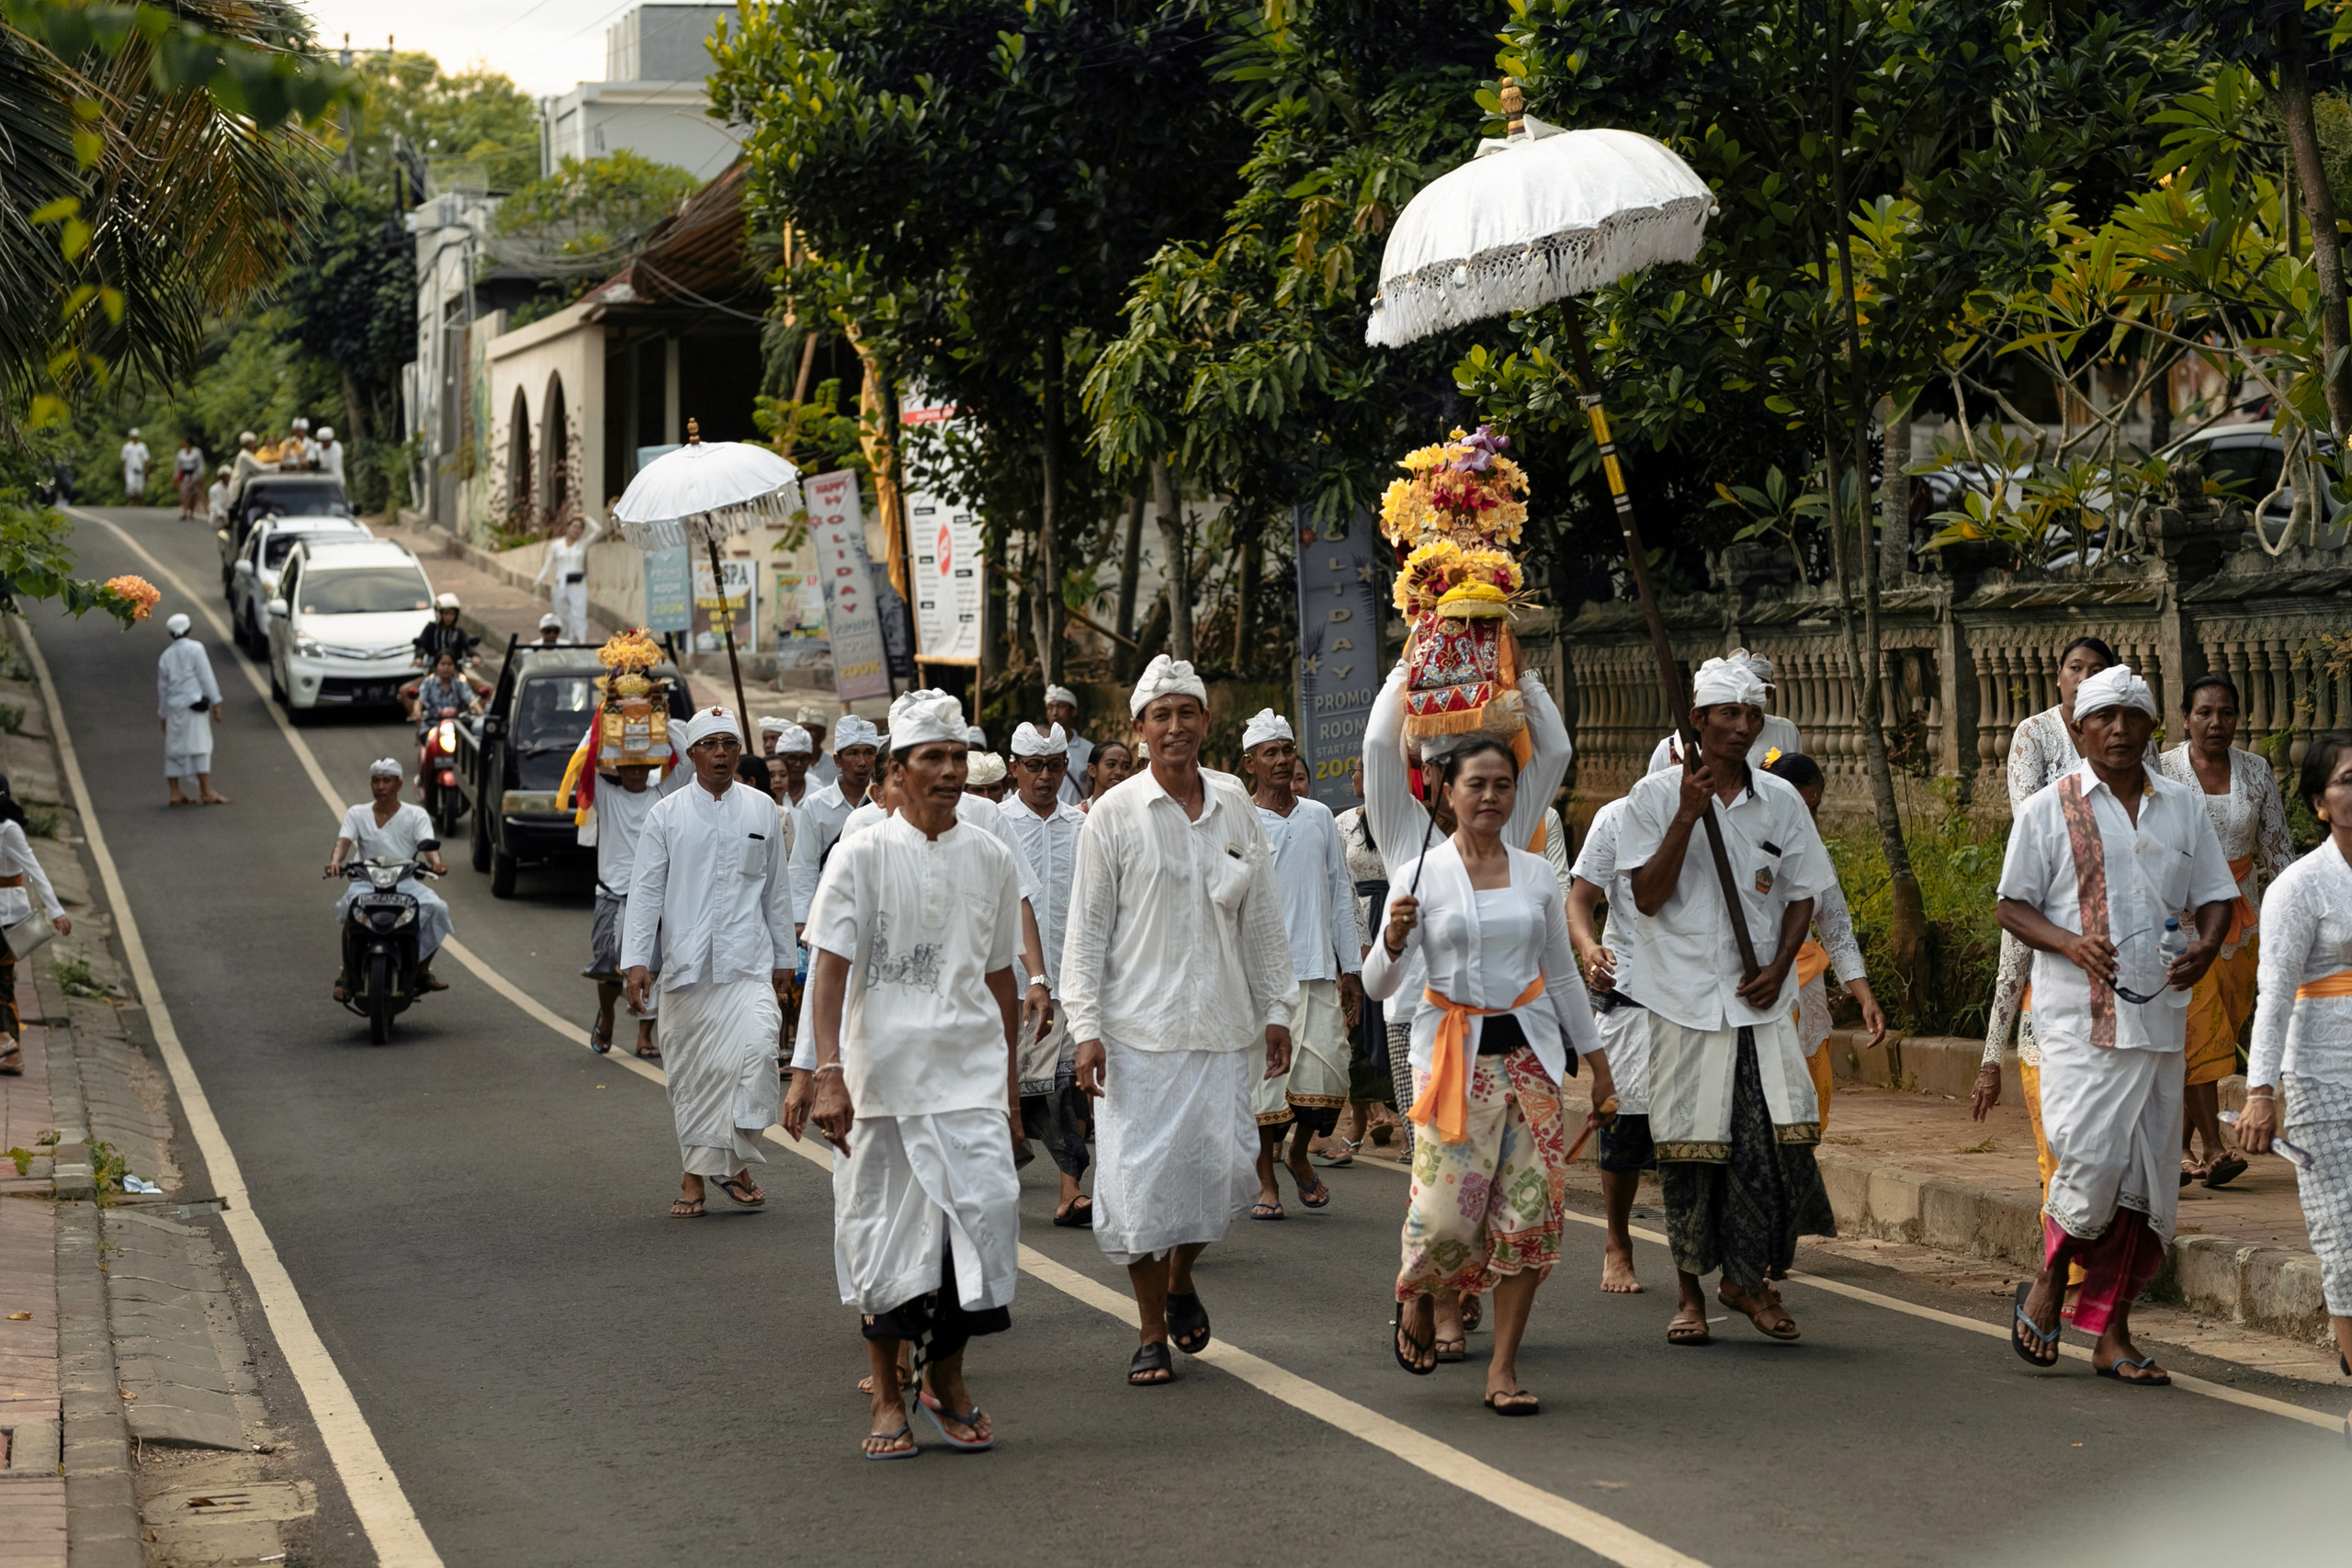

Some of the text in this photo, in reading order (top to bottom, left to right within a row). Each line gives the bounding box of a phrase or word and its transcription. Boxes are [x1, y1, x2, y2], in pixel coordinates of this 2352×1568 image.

[824, 494, 856, 613] HOLIDAY
[722, 563, 749, 585] SPA
[840, 660, 879, 679] 200K
[1316, 687, 1373, 713] PROMO
[1320, 717, 1366, 740] ROOM
[1317, 742, 1346, 758] START
